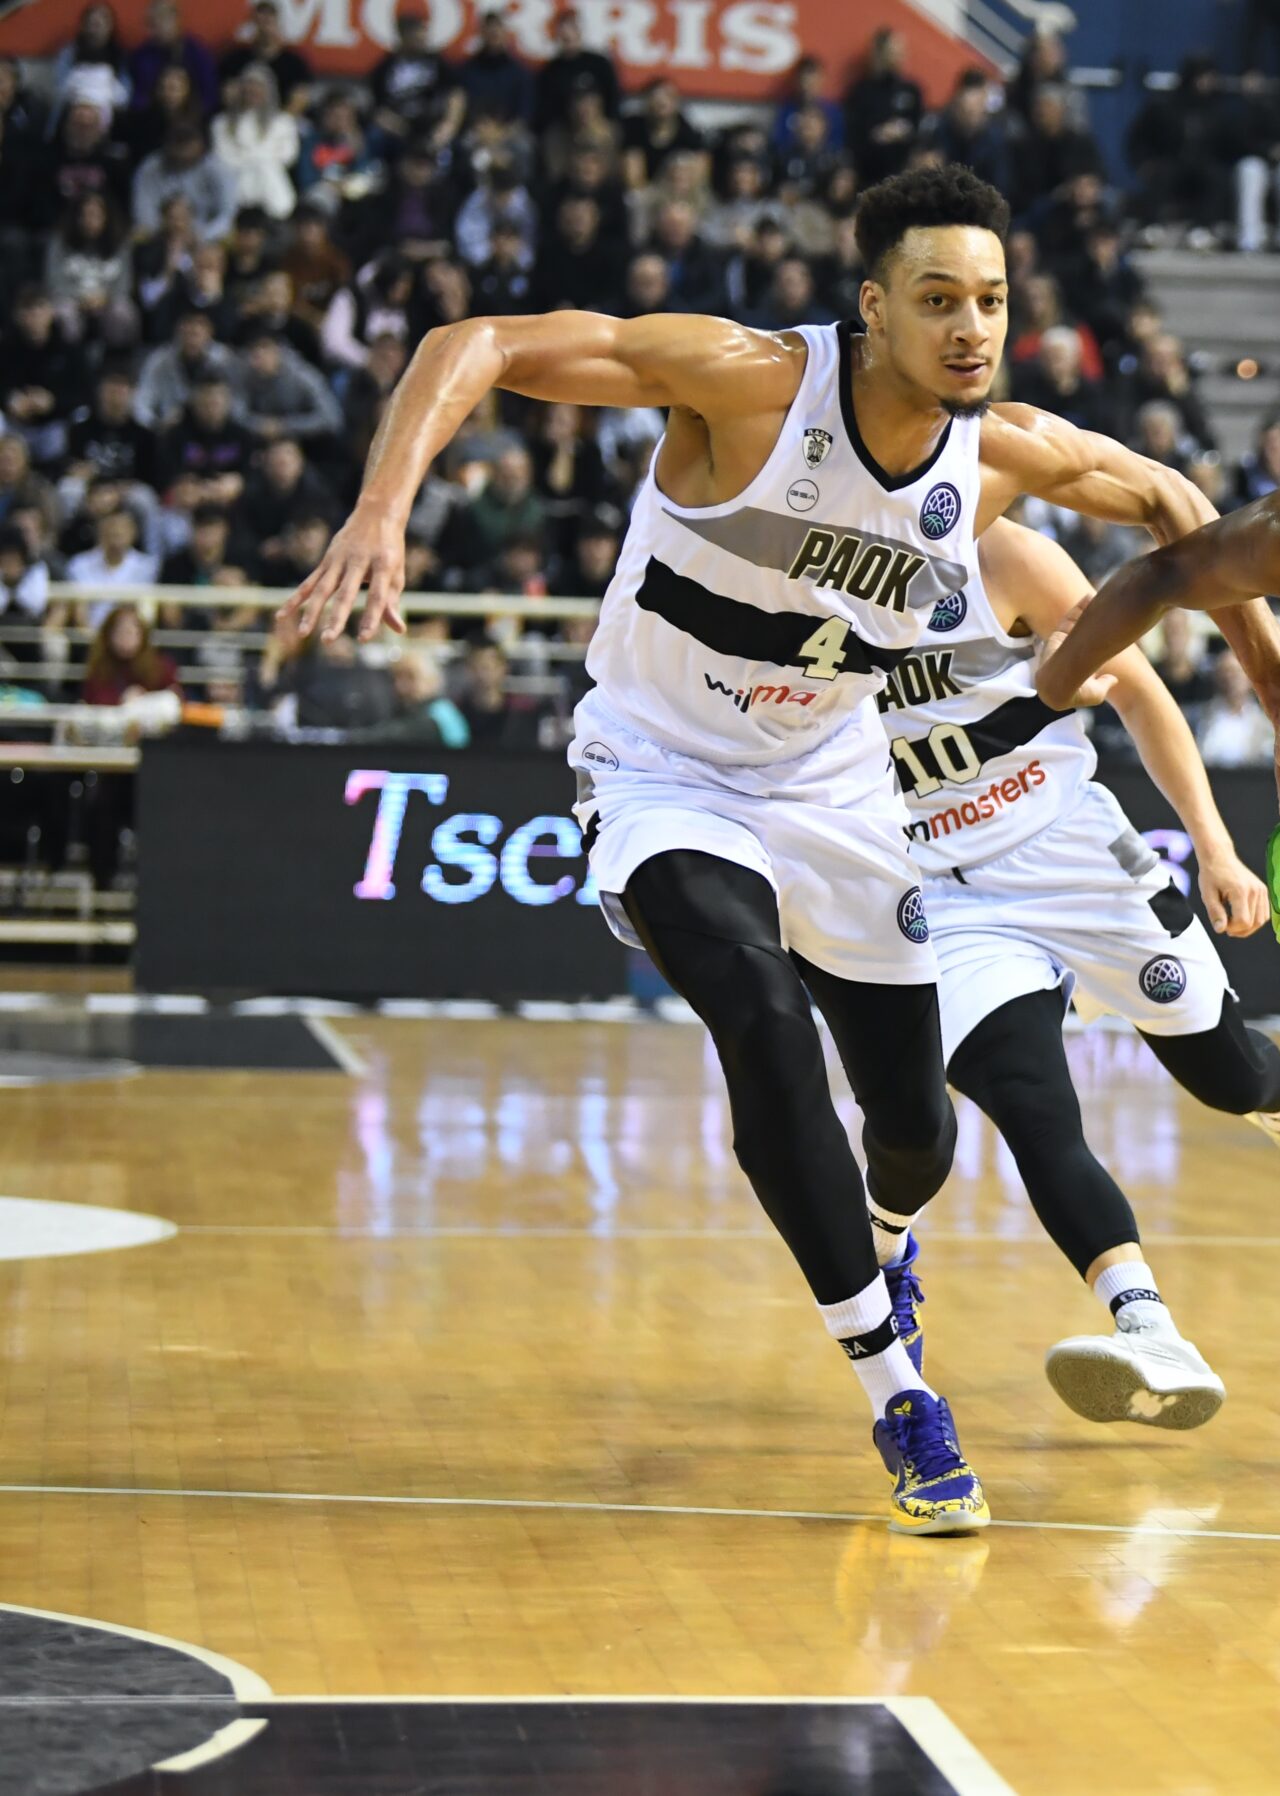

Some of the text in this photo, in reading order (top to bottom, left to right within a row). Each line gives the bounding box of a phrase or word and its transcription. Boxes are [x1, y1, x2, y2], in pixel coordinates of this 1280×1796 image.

[234, 0, 799, 74] MORRIS
[787, 527, 930, 614] PAOK
[798, 614, 853, 681] 4
[874, 649, 963, 715] AOK
[584, 751, 617, 767] GSA
[891, 722, 983, 800] 10
[344, 769, 600, 906] Tse
